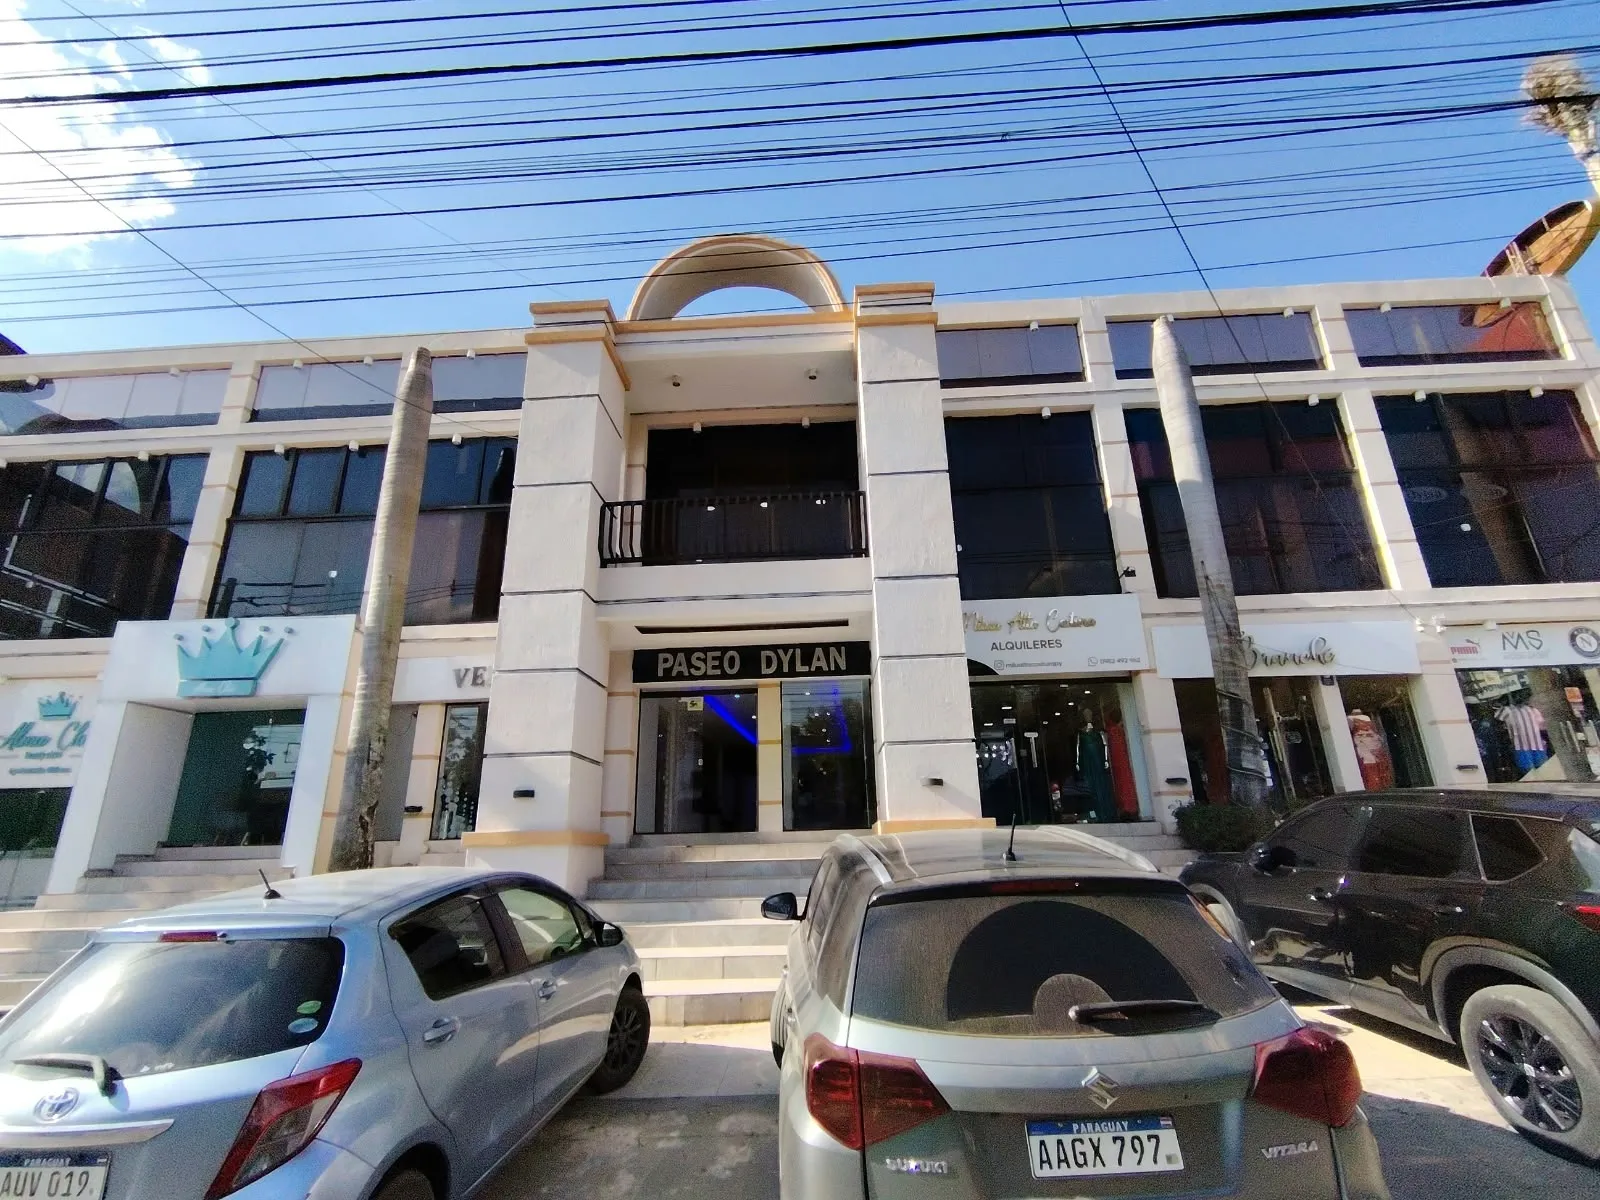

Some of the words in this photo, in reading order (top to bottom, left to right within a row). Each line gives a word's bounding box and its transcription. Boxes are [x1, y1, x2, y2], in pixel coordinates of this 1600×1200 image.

[990, 638, 1063, 652] ALQUILERES
[657, 650, 741, 677] PASEO
[760, 646, 847, 675] DYLAN
[452, 666, 491, 689] VE
[1072, 1119, 1129, 1134] PARAGUAY
[1039, 1136, 1106, 1170] AAGX
[1111, 1134, 1161, 1166] 797
[47, 1170, 90, 1197] 019
